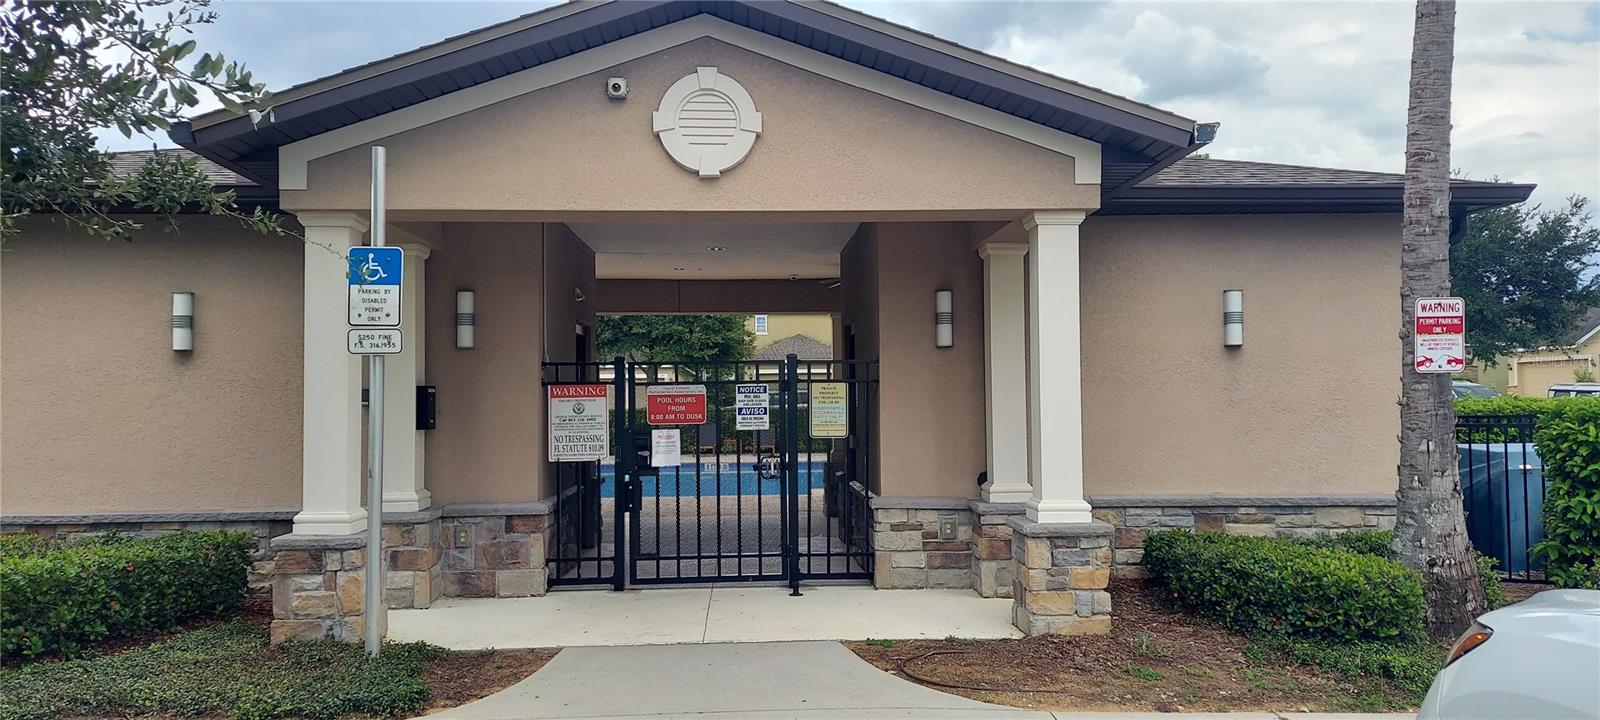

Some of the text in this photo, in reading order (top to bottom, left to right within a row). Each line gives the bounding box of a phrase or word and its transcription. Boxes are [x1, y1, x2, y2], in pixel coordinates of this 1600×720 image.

[1420, 303, 1460, 313] WARNING
[552, 387, 605, 396] WARNING
[554, 434, 604, 443] NO TRESPASSING
[554, 445, 561, 453] FL
[562, 444, 588, 452] STATUTE
